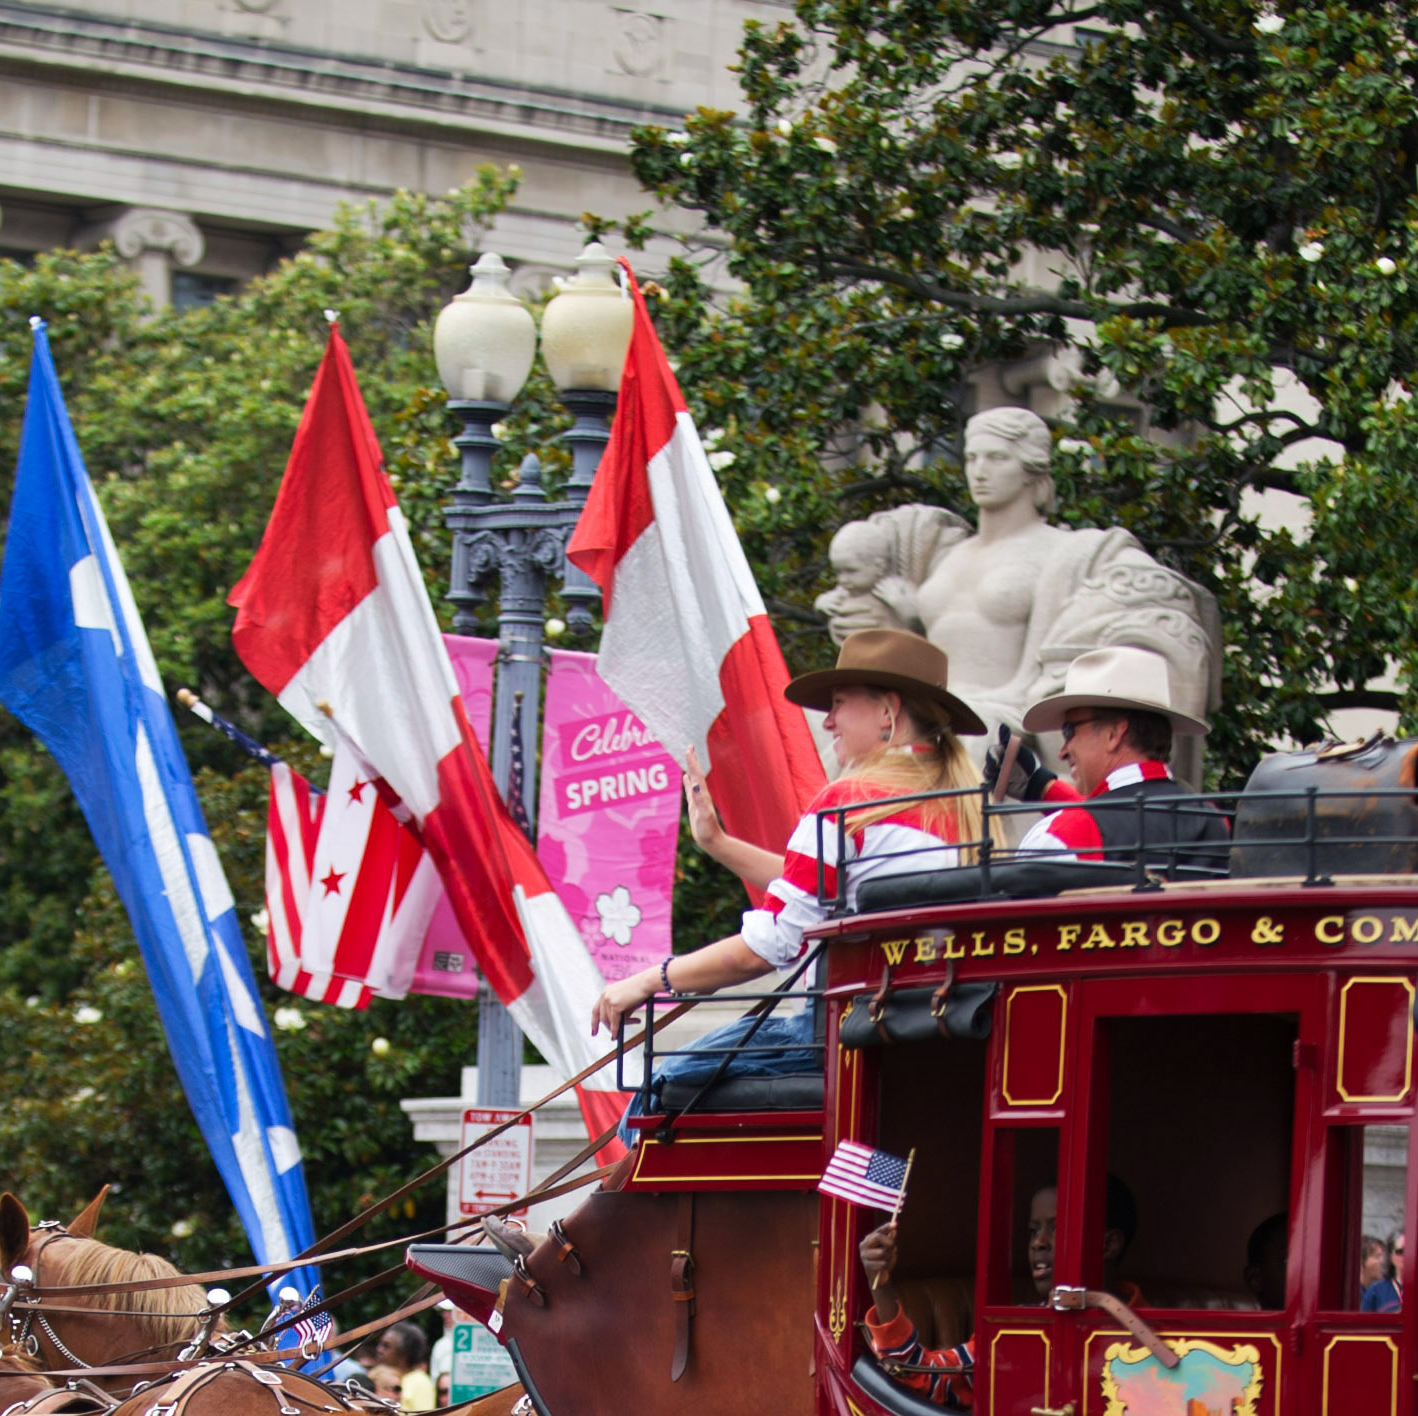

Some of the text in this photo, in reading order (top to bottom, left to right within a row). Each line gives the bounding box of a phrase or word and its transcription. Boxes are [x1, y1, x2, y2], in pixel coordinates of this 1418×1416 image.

[566, 763, 668, 809] SPRING
[881, 928, 1039, 966] WELLS,
[1056, 918, 1221, 951] FARGO
[1250, 916, 1284, 944] &
[457, 1329, 469, 1350] 2
